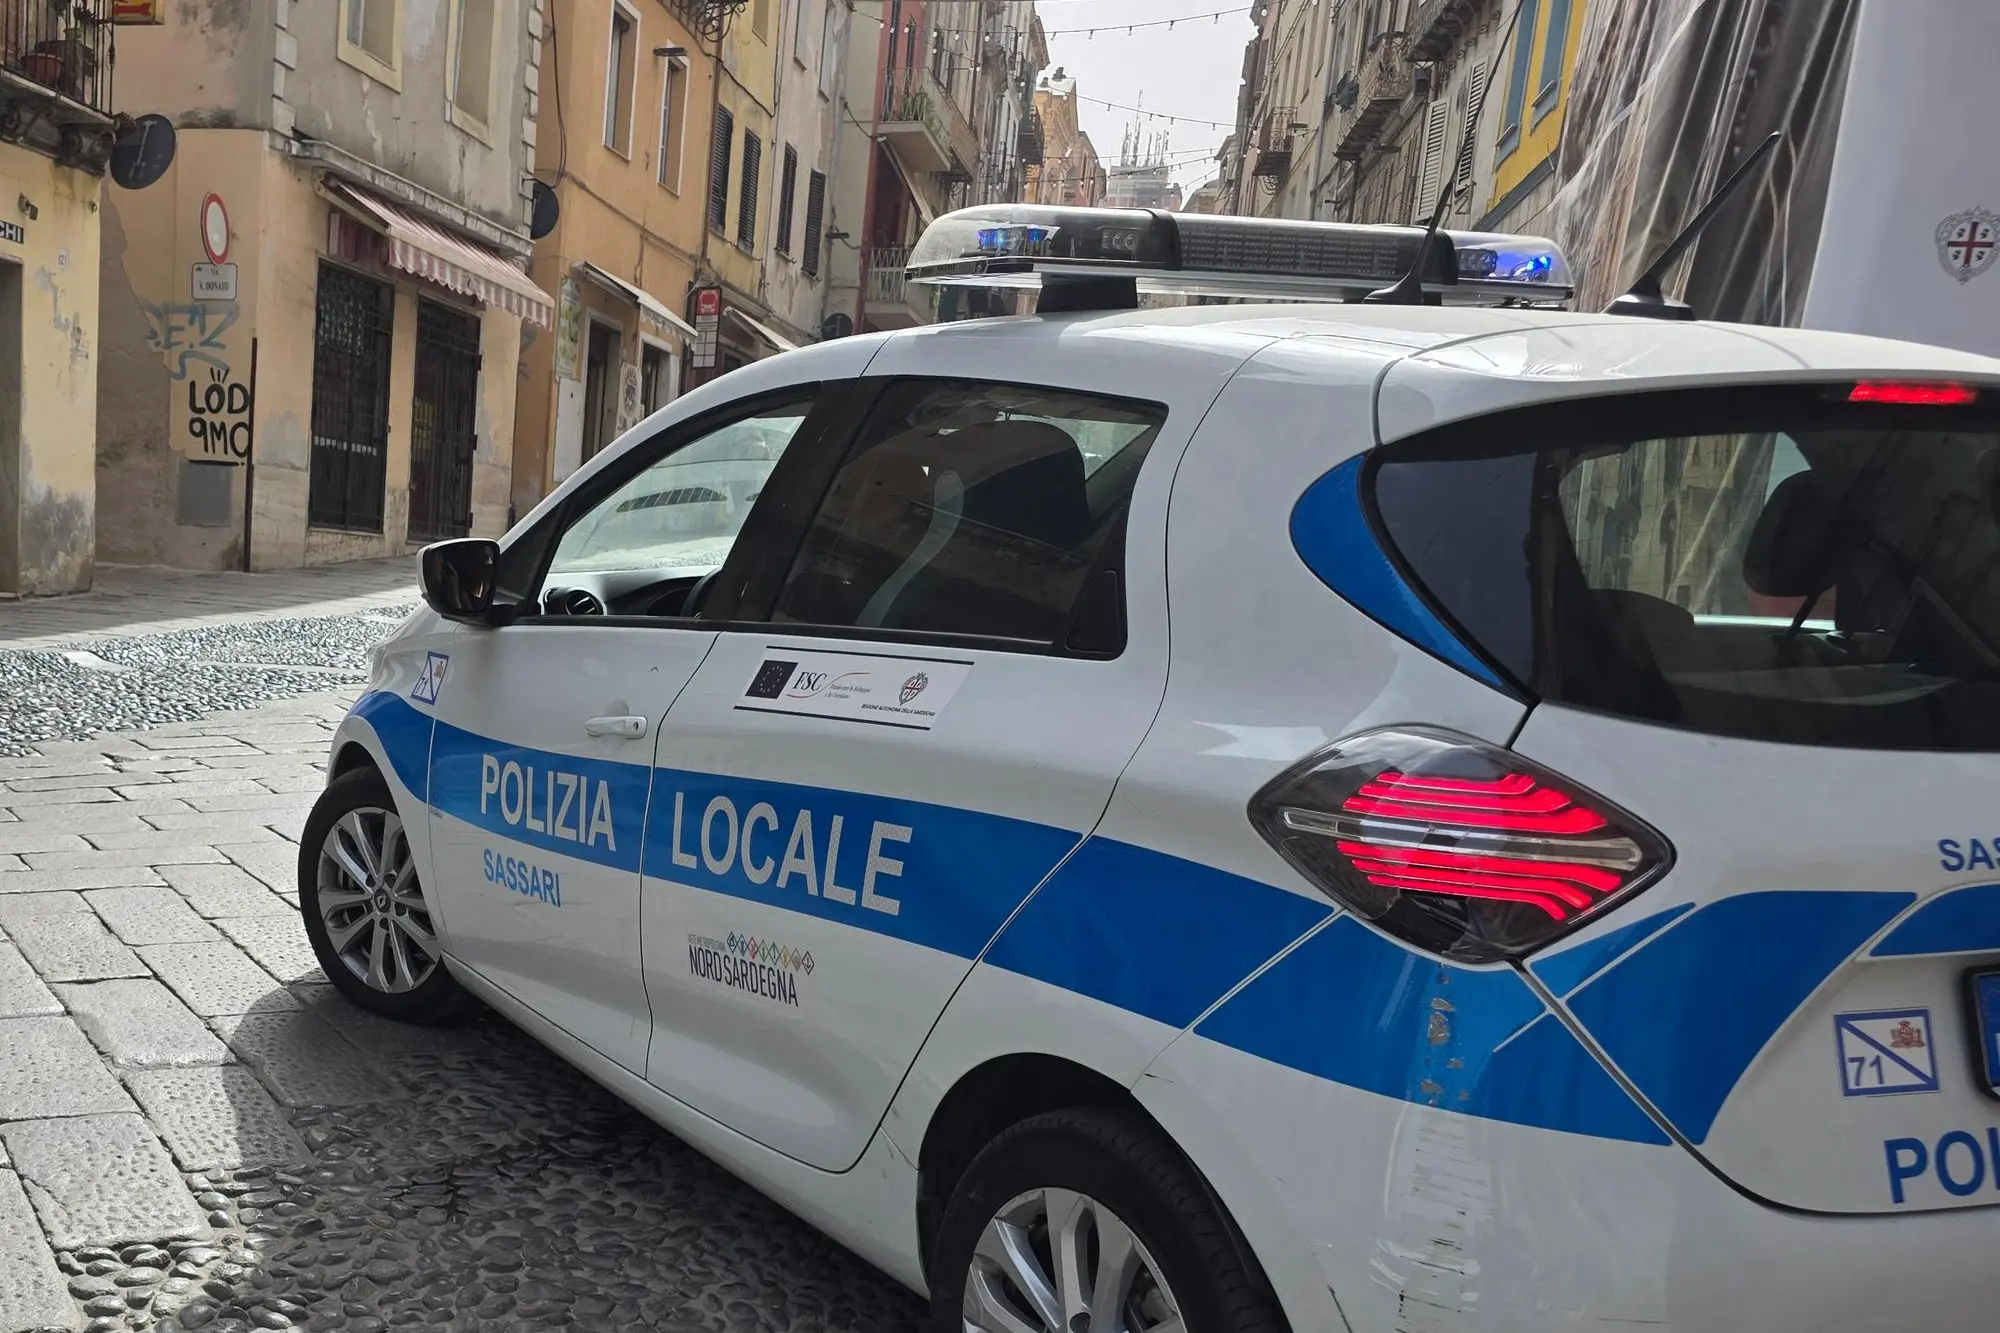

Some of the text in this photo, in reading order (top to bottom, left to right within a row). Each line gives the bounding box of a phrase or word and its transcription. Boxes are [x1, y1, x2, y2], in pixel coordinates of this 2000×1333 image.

[415, 677, 430, 695] 71
[794, 671, 828, 692] FSC
[481, 753, 913, 916] POLIZIA LOCALE
[483, 848, 561, 908] SASSARI
[689, 944, 798, 1007] NORD SARDEGNA
[1848, 1055, 1884, 1086] 71
